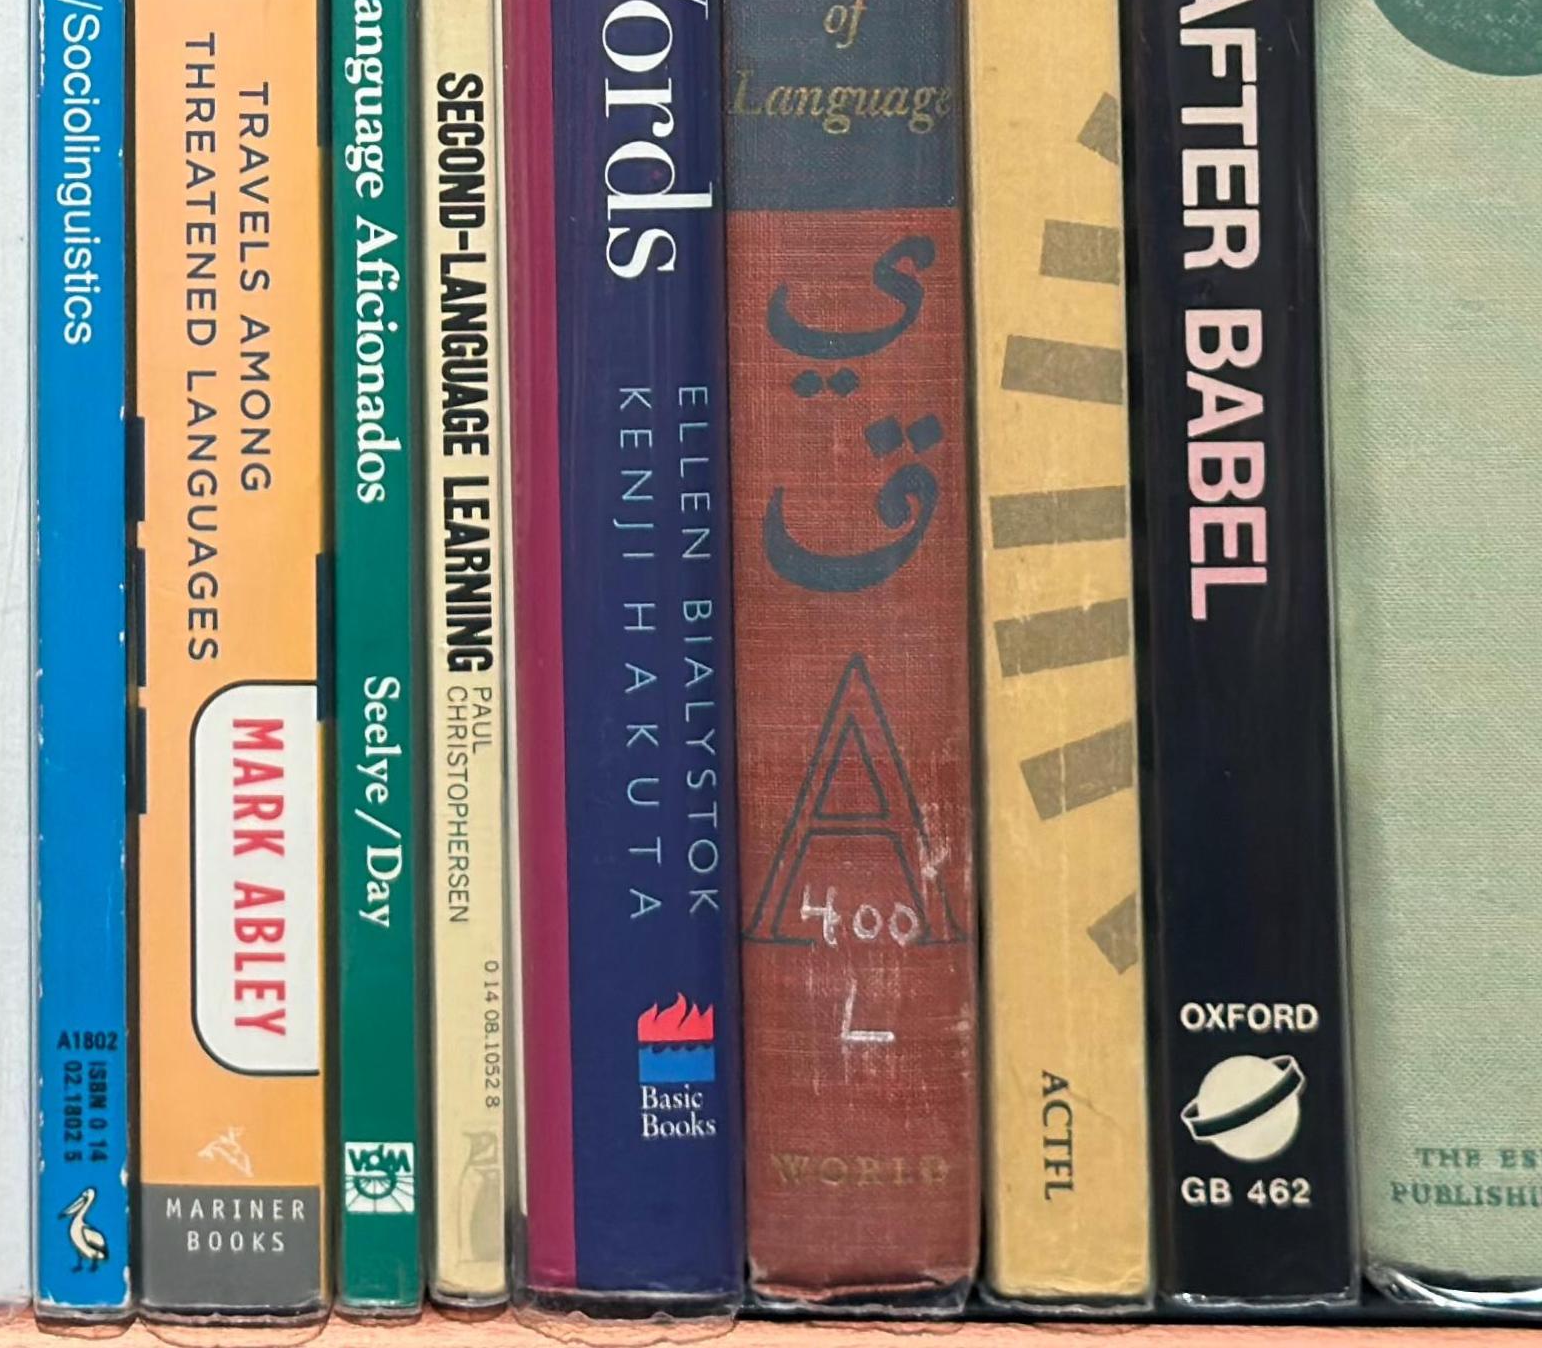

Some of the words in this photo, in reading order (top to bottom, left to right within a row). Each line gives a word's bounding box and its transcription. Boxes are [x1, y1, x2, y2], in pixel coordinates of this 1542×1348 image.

[725, 69, 951, 134] Language
[185, 32, 217, 347] THREATENED
[239, 82, 270, 292] TRAVELS
[436, 71, 489, 457] SECOND-LANGUAGE
[240, 315, 271, 492] AMONG
[354, 215, 402, 504] Aficionados
[186, 370, 218, 661] LANGUAGES
[613, 386, 655, 558] KENJI
[678, 386, 712, 559] ELLEN
[1184, 309, 1267, 620] BABEL
[443, 476, 494, 673] LEARNING
[232, 719, 286, 857] MARK
[472, 685, 492, 754] PAUL
[623, 602, 661, 920] HAKUTA
[682, 599, 719, 915] BIALYSTOK
[446, 685, 470, 924] CHRISTOPHERSEN
[233, 881, 287, 1037] ABLEY
[1180, 1003, 1318, 1031] OXFORD
[57, 1030, 118, 1051] A1802
[88, 1060, 107, 1109] ISBN
[641, 1087, 703, 1111] Basic
[641, 1114, 717, 1138] Books
[1041, 1070, 1074, 1200] ACTFL
[1181, 1176, 1231, 1204] GB
[1248, 1176, 1311, 1204] 462
[1416, 1147, 1479, 1169] THE
[165, 1198, 306, 1221] MARINER
[186, 1231, 286, 1253] BOOKS
